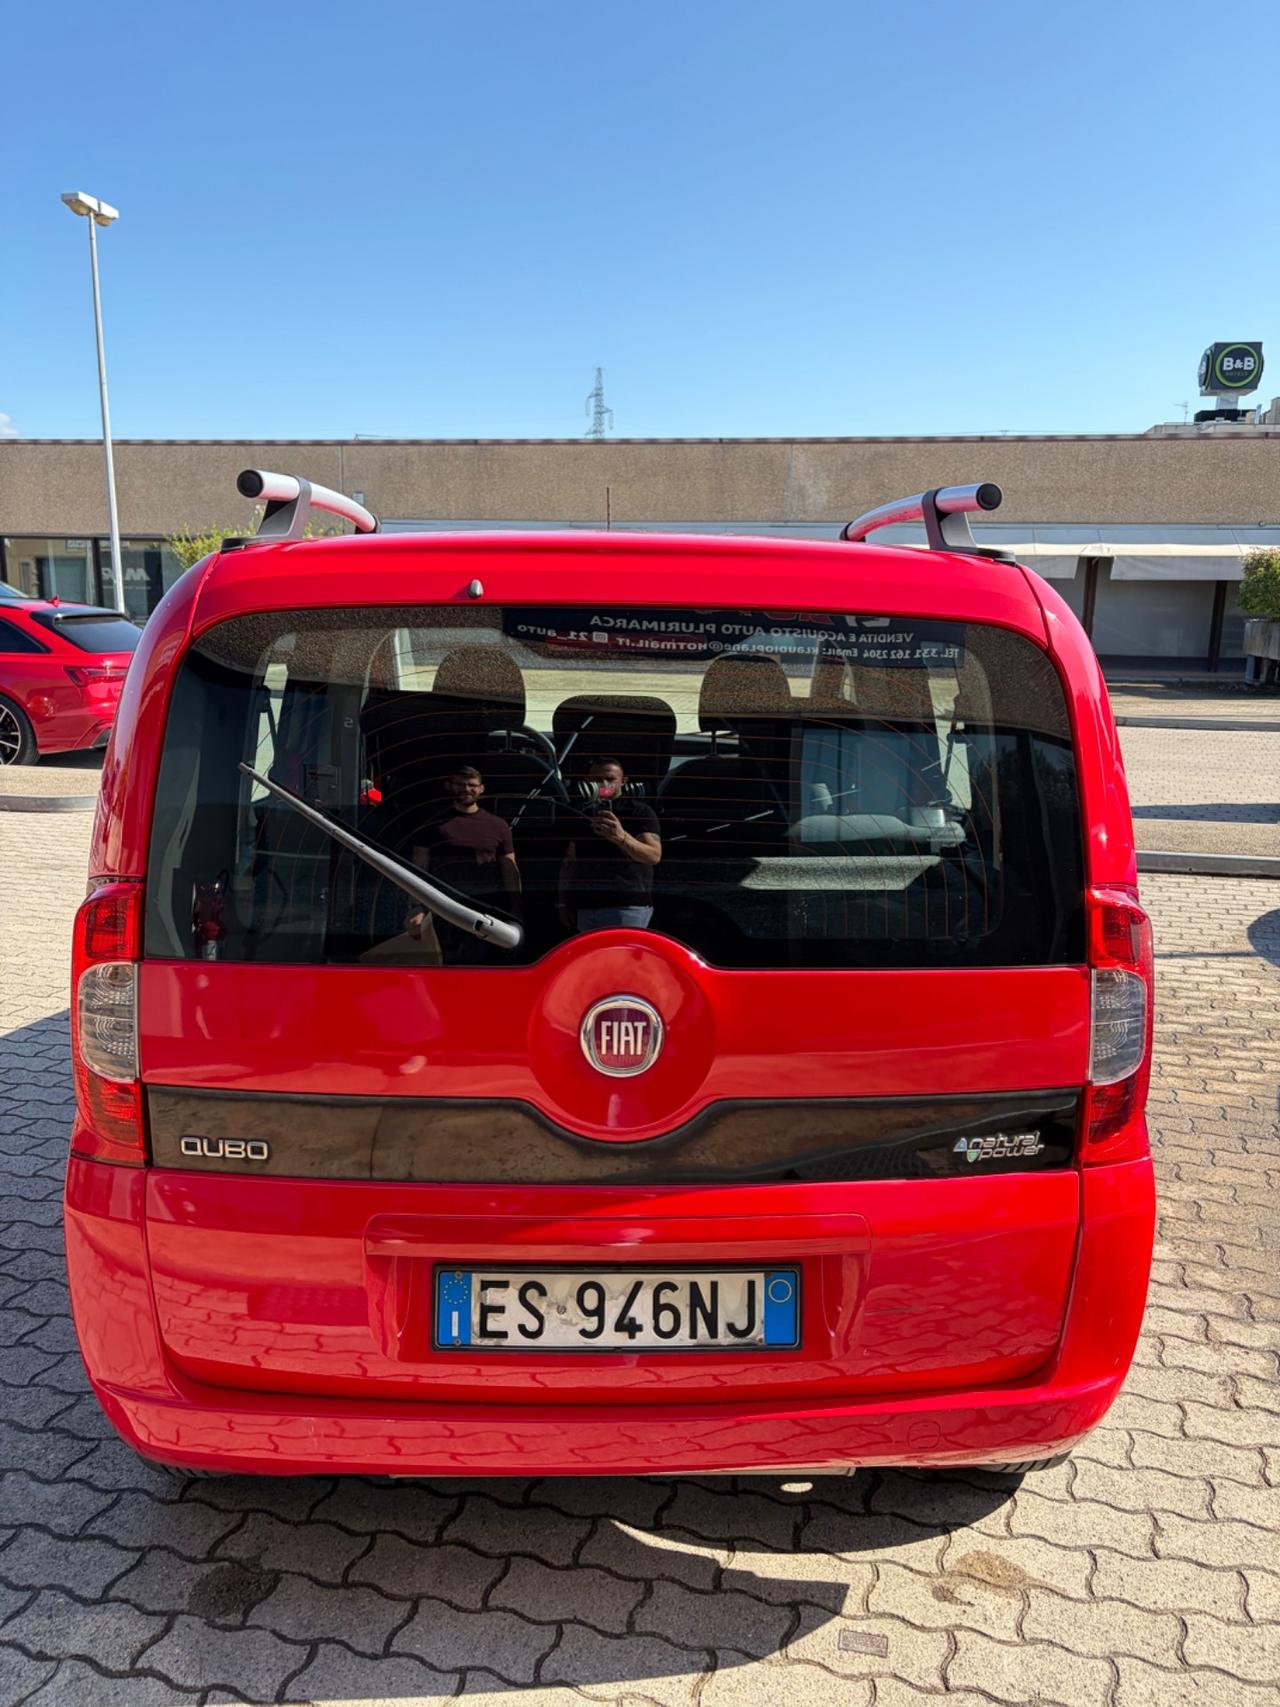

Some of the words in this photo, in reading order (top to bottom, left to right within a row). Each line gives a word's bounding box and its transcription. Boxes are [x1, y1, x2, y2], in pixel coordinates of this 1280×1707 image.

[1223, 357, 1254, 371] B&B
[101, 567, 151, 581] RM
[601, 1021, 647, 1056] FIAT
[181, 1136, 268, 1160] QUBO
[969, 1130, 1040, 1149] natural
[978, 1144, 1045, 1161] power
[479, 1279, 548, 1340] ES
[575, 1280, 756, 1340] 946NJ
